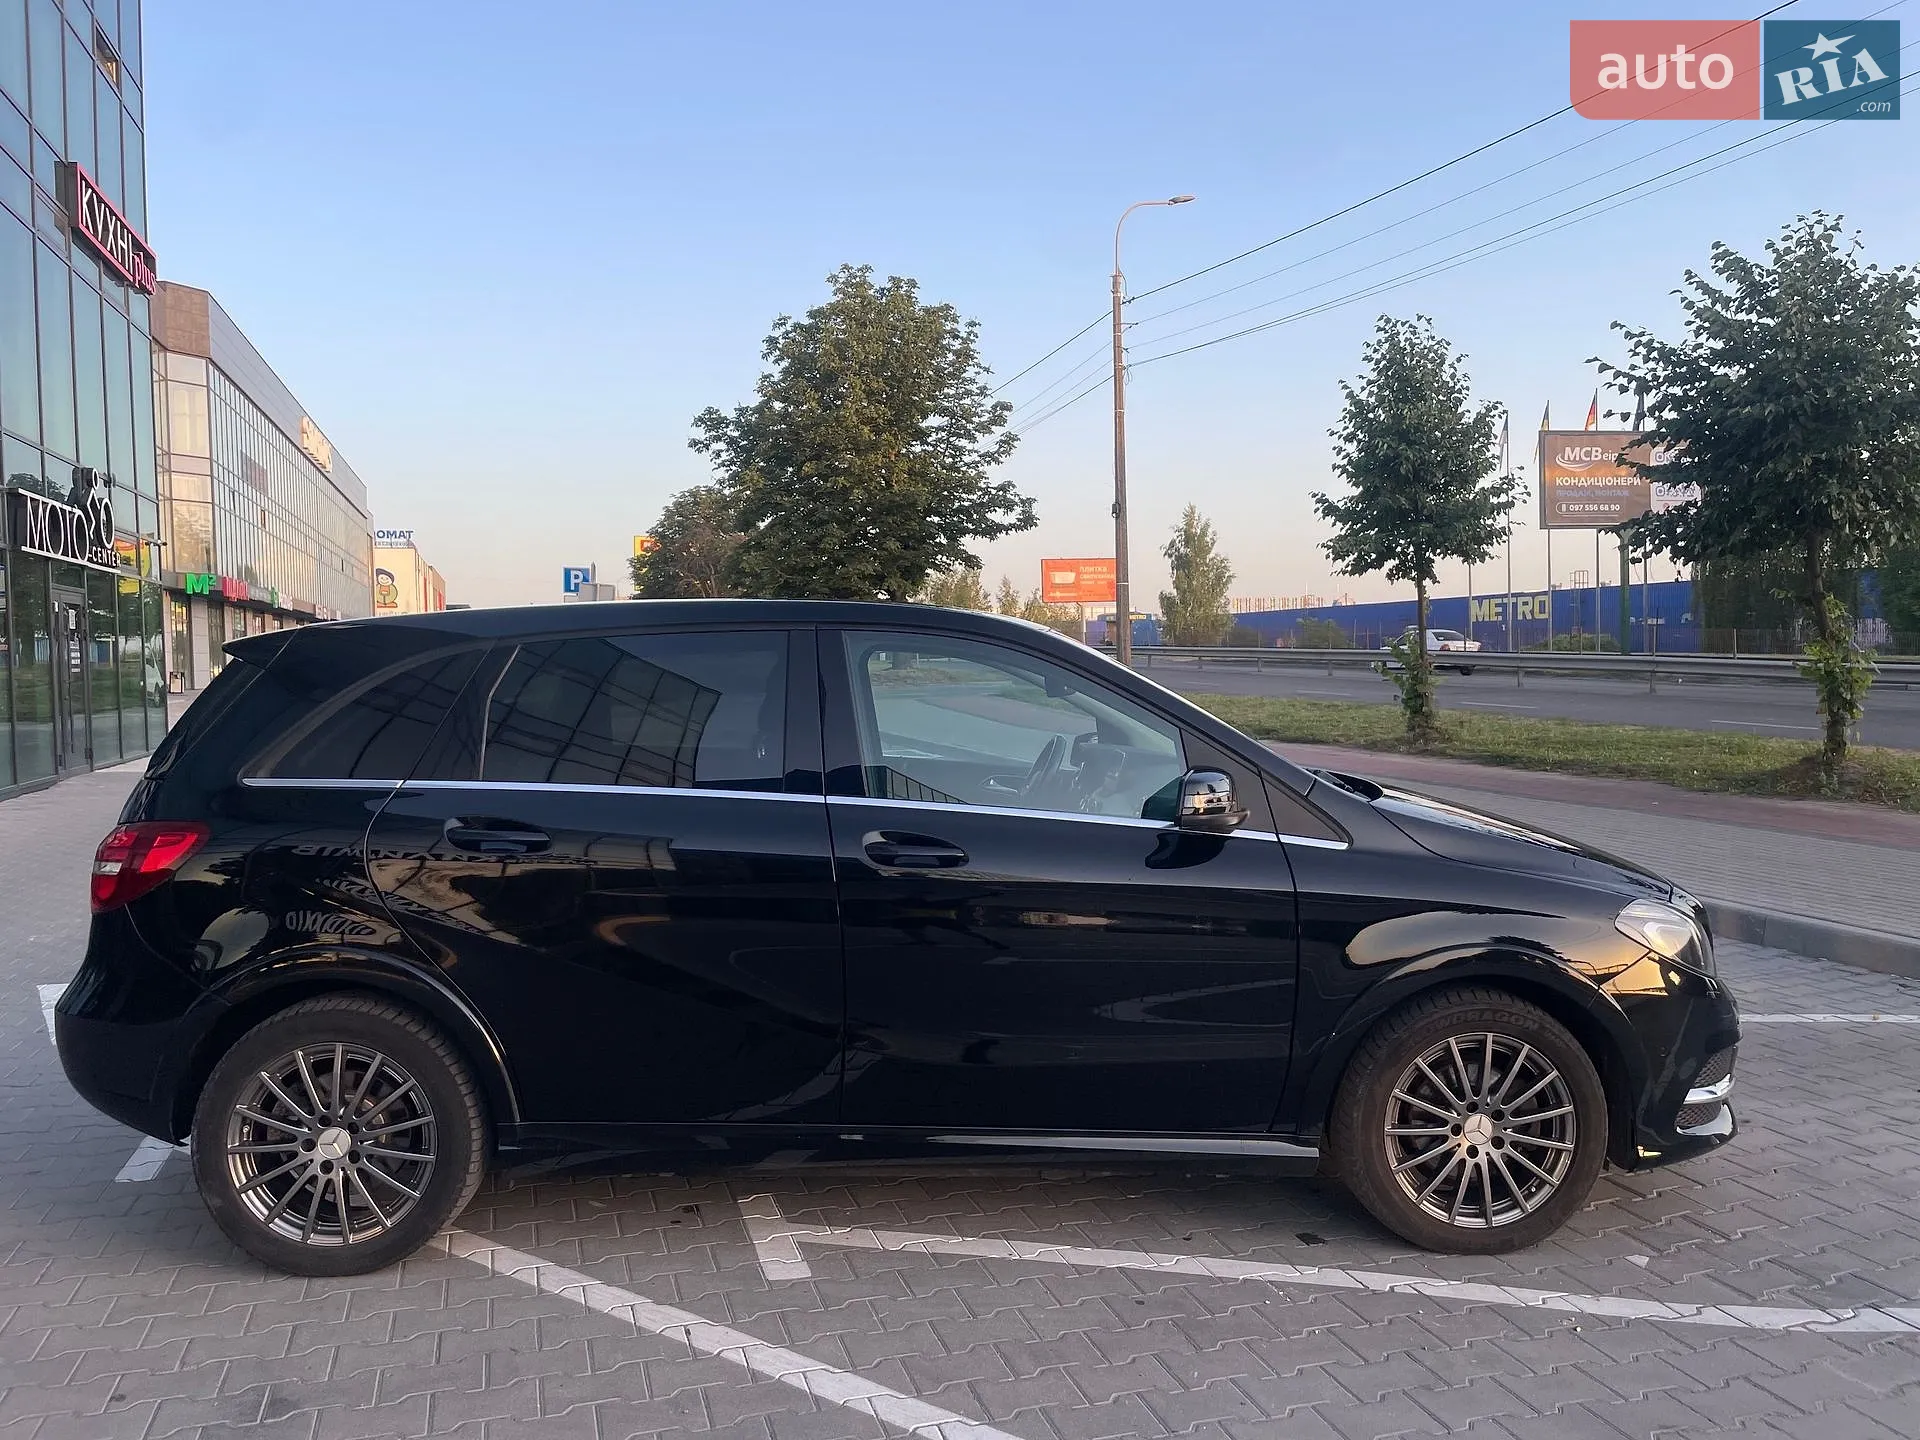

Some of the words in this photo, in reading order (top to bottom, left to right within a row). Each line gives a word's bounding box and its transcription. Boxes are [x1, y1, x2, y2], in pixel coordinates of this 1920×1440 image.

[82, 179, 134, 275] КУХНІ
[133, 251, 157, 296] plus
[1471, 595, 1549, 622] METRO
